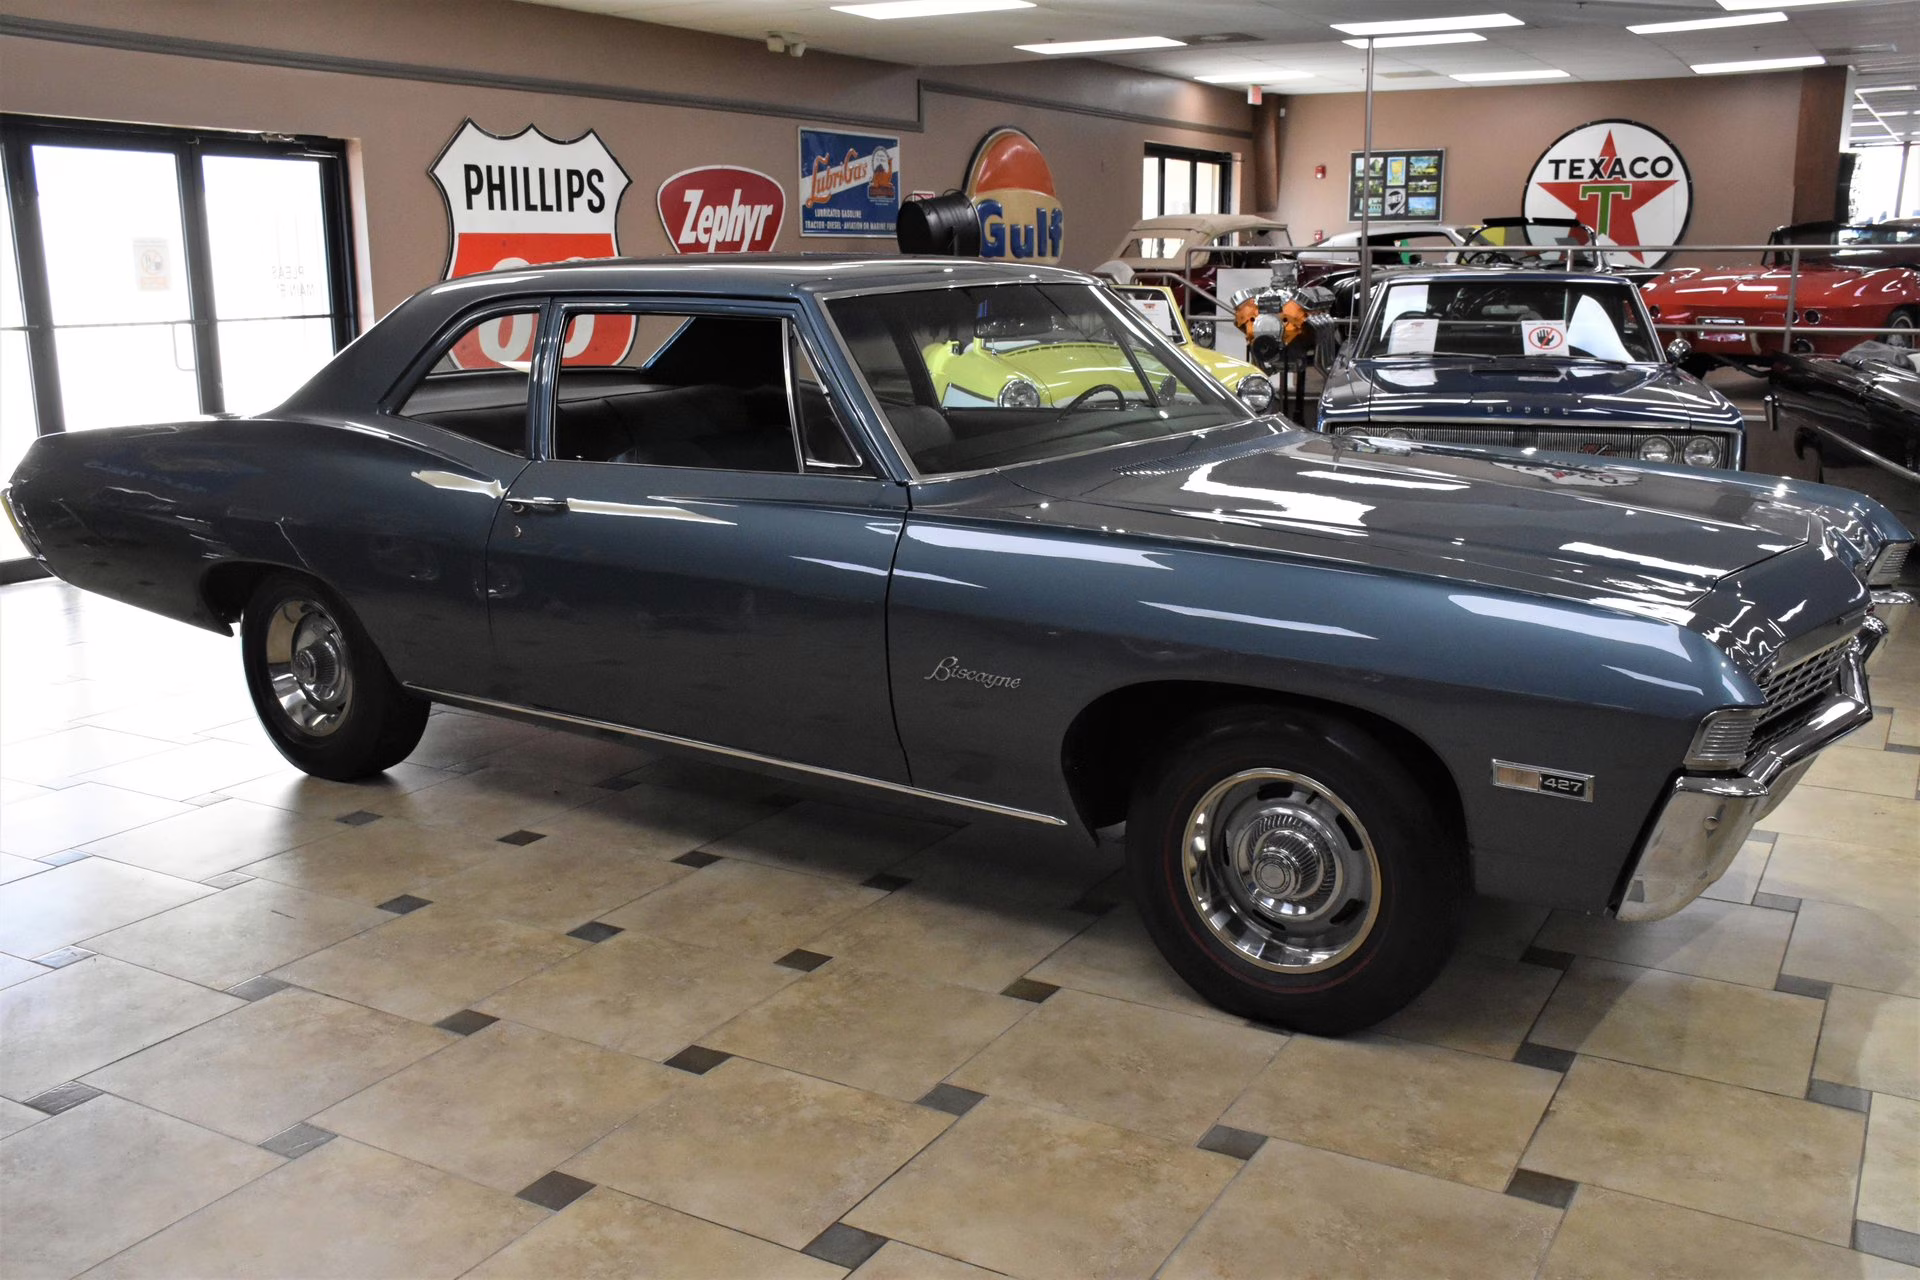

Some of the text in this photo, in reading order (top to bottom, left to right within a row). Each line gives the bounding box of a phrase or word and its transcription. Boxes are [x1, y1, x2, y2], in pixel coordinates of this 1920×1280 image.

[464, 164, 605, 213] PHILLIPS
[1548, 156, 1673, 180] TEXACO
[678, 188, 774, 253] Zephyr
[977, 199, 1063, 259] Gulf
[923, 655, 1022, 689] Biscayne
[1543, 777, 1583, 792] 427
